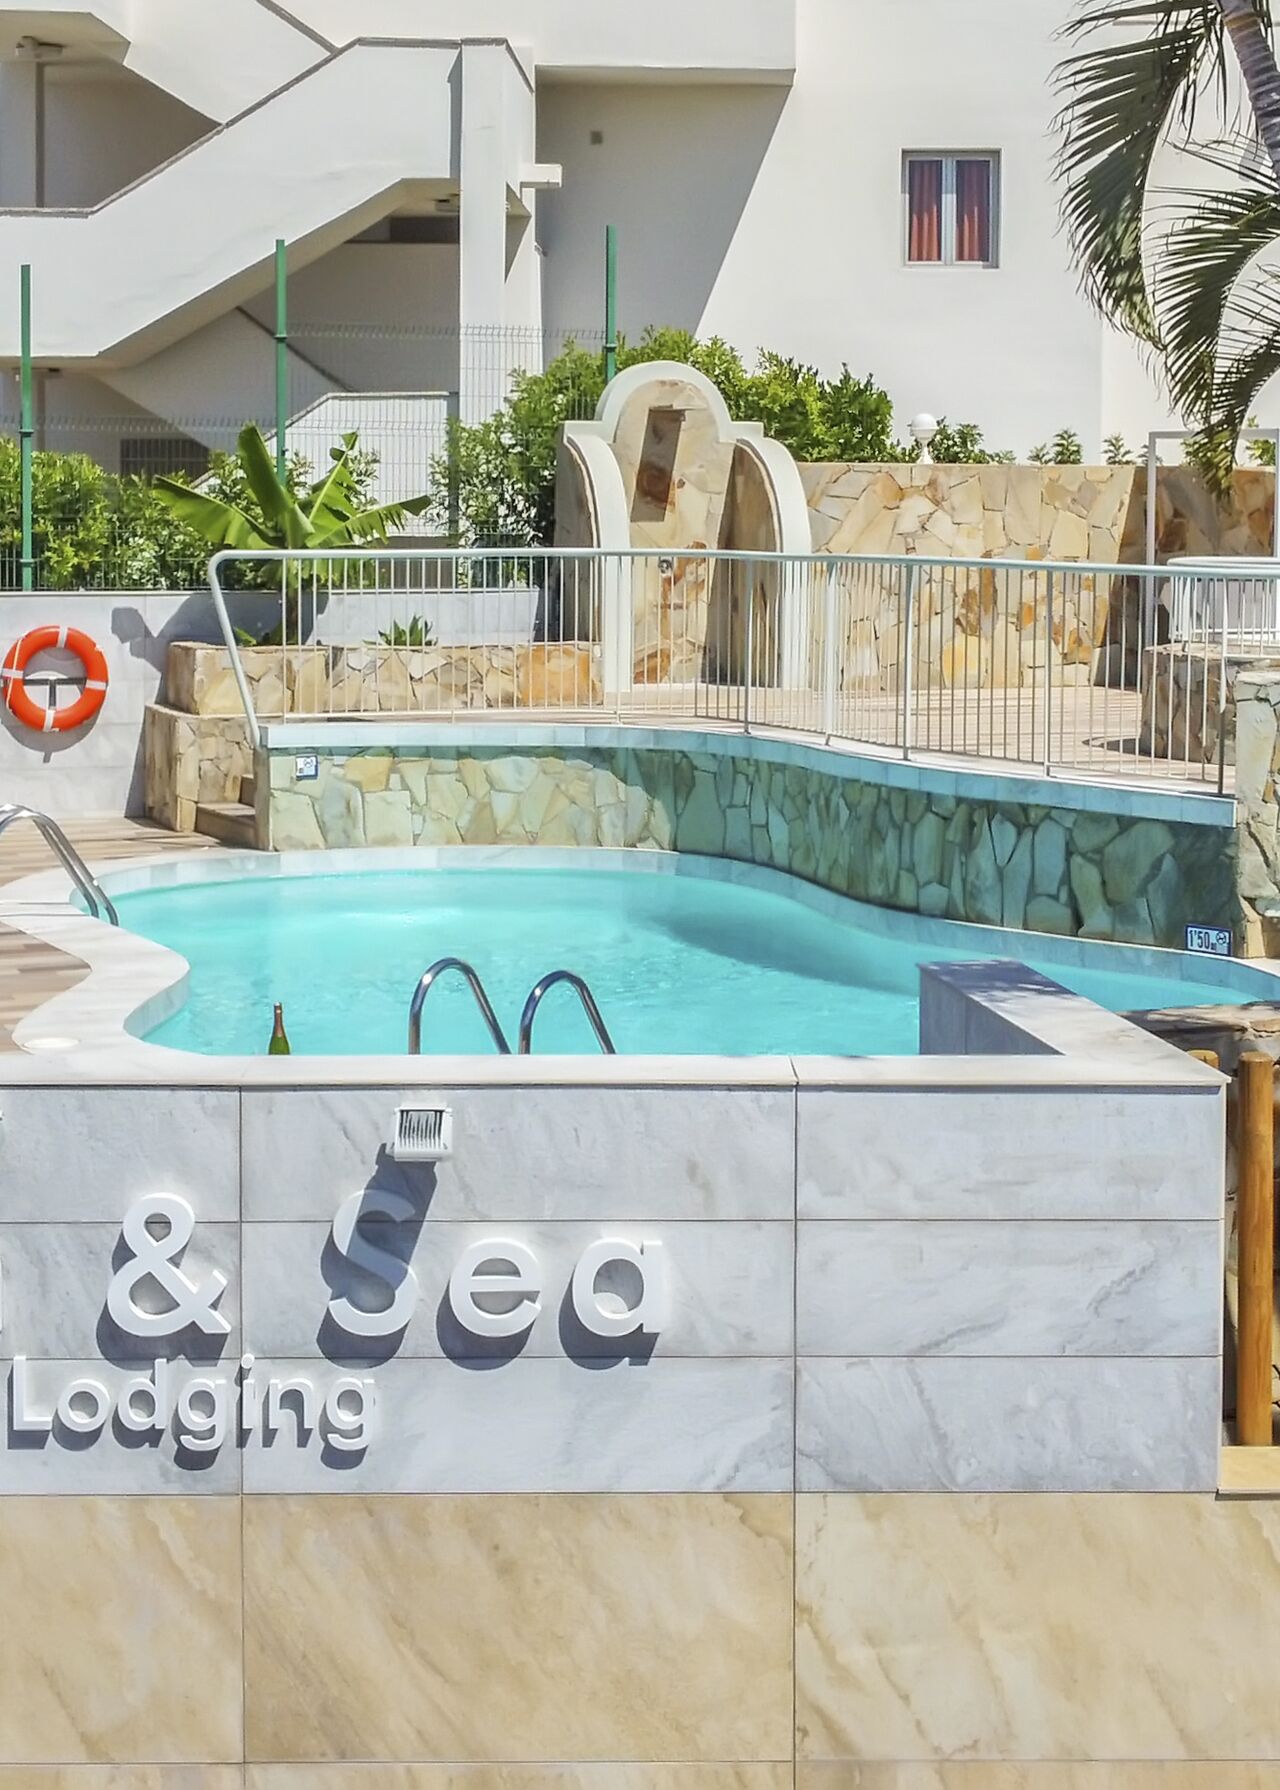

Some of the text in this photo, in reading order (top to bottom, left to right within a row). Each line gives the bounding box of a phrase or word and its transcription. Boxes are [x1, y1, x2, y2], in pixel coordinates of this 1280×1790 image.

[107, 1192, 232, 1338] &
[326, 1189, 665, 1338] Sea
[13, 1353, 376, 1452] Lodging
